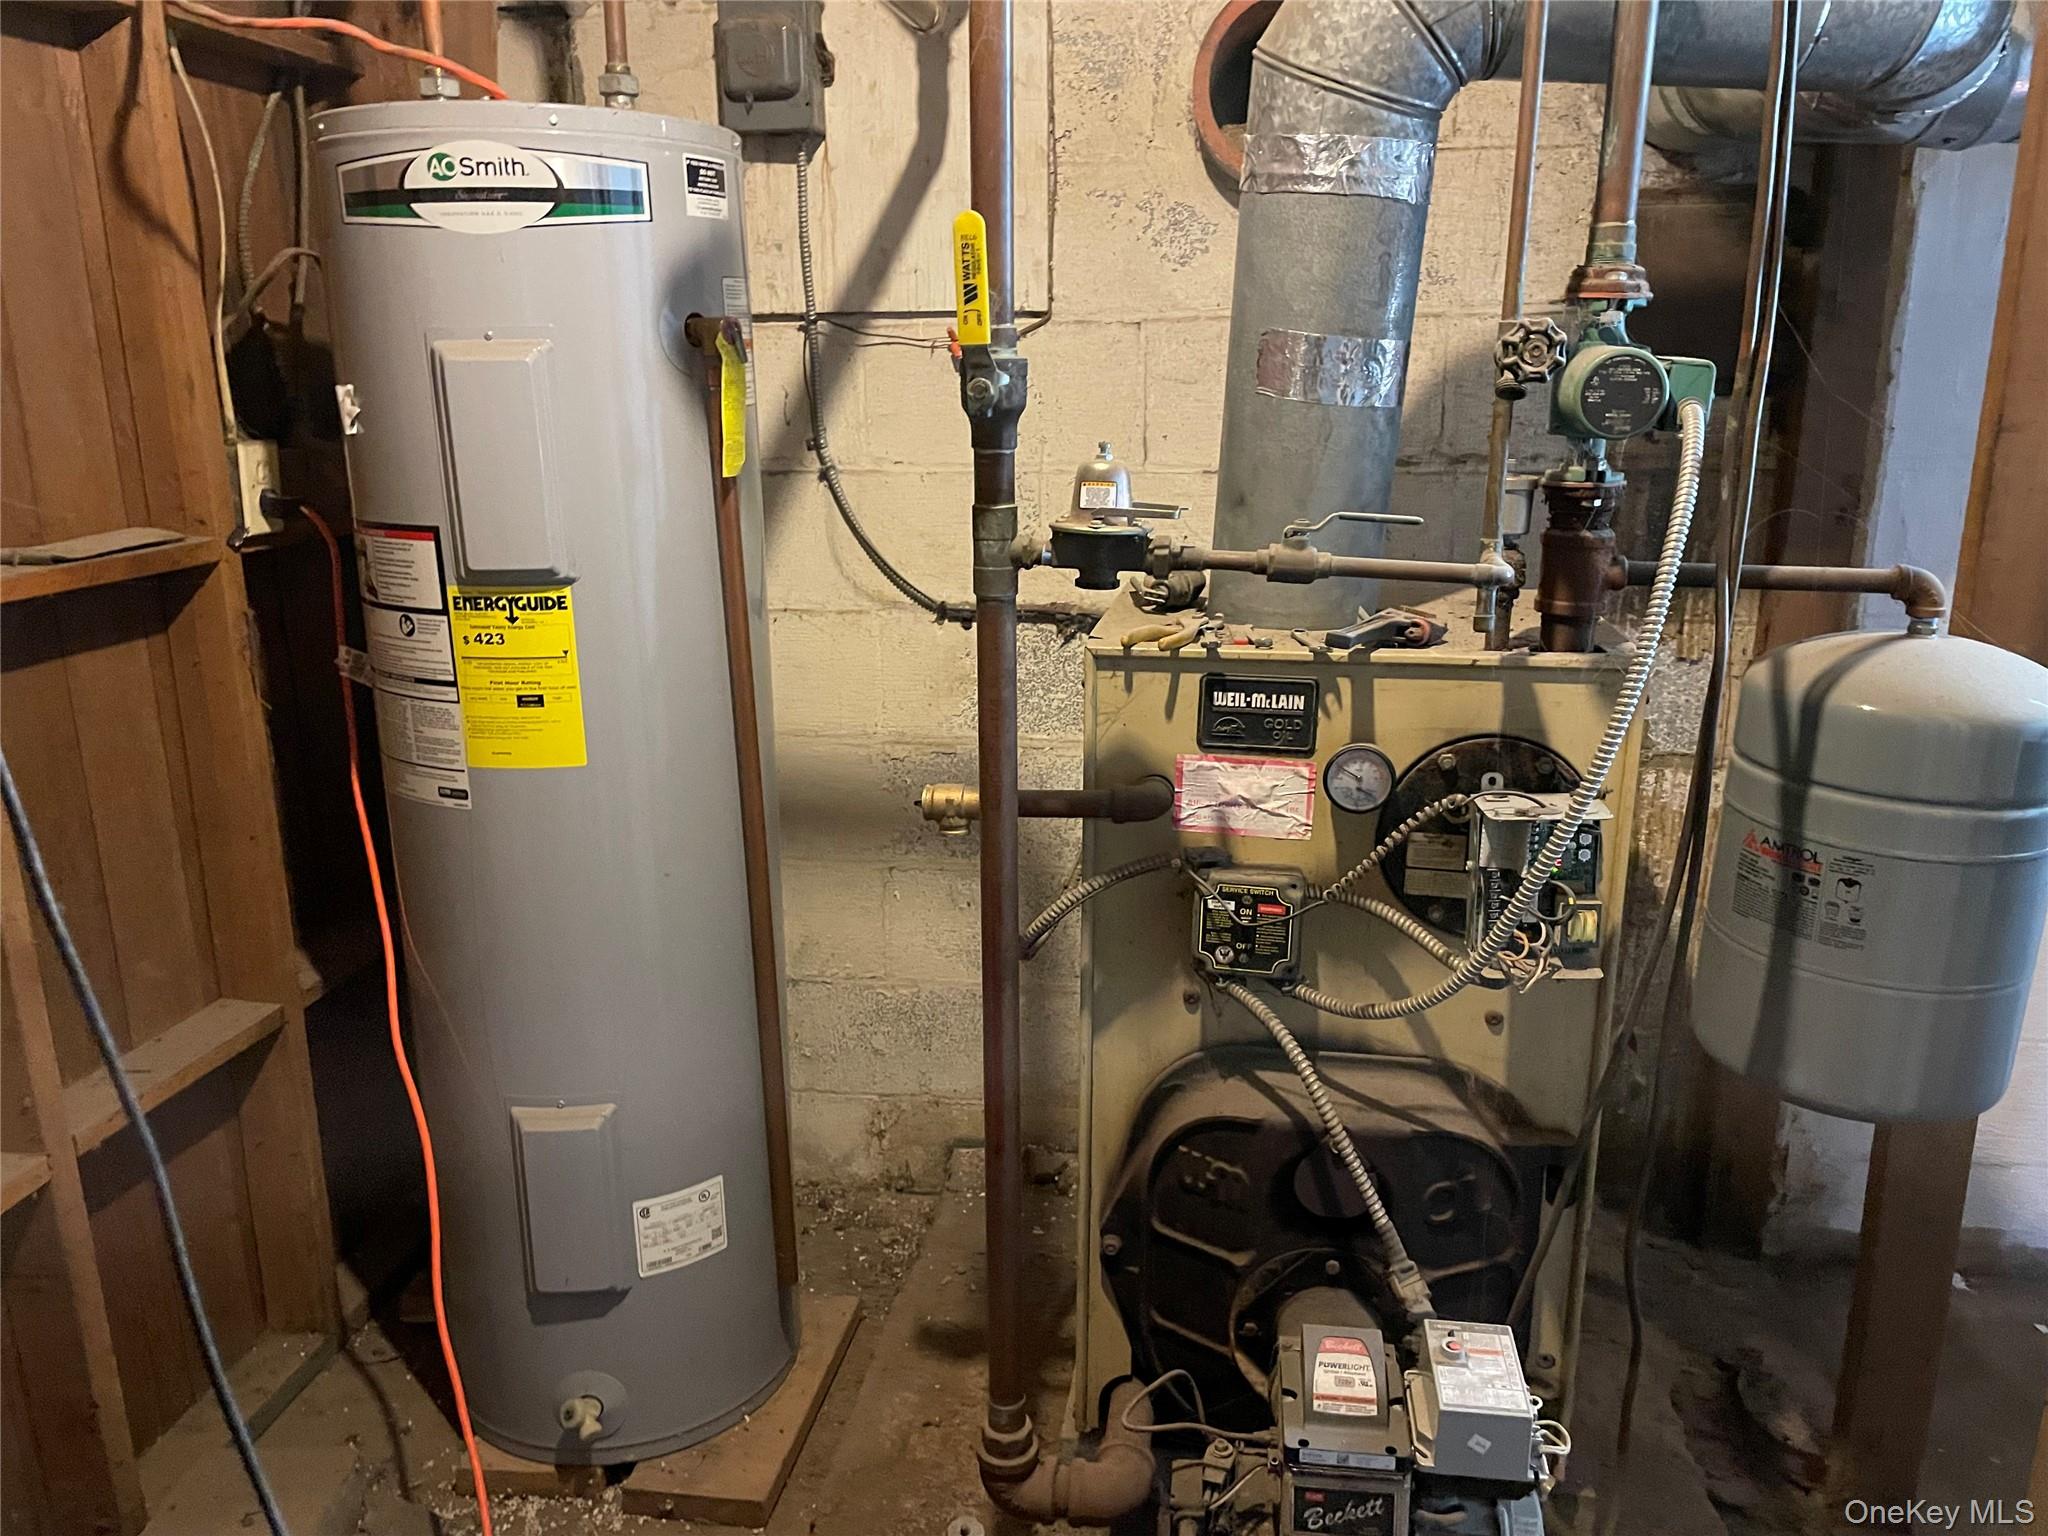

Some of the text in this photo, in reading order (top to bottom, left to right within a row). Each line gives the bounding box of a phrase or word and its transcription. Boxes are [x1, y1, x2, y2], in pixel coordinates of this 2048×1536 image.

[961, 242, 971, 281] WATTS
[453, 595, 568, 613] ENERGYGUIDE
[473, 633, 505, 646] 423
[1263, 717, 1304, 730] GOLD
[1221, 886, 1274, 896] SERVICE SWITCH
[1239, 907, 1253, 916] ON
[1318, 1361, 1371, 1372] POWERLIGHT
[1303, 1497, 1384, 1530] Beckett
